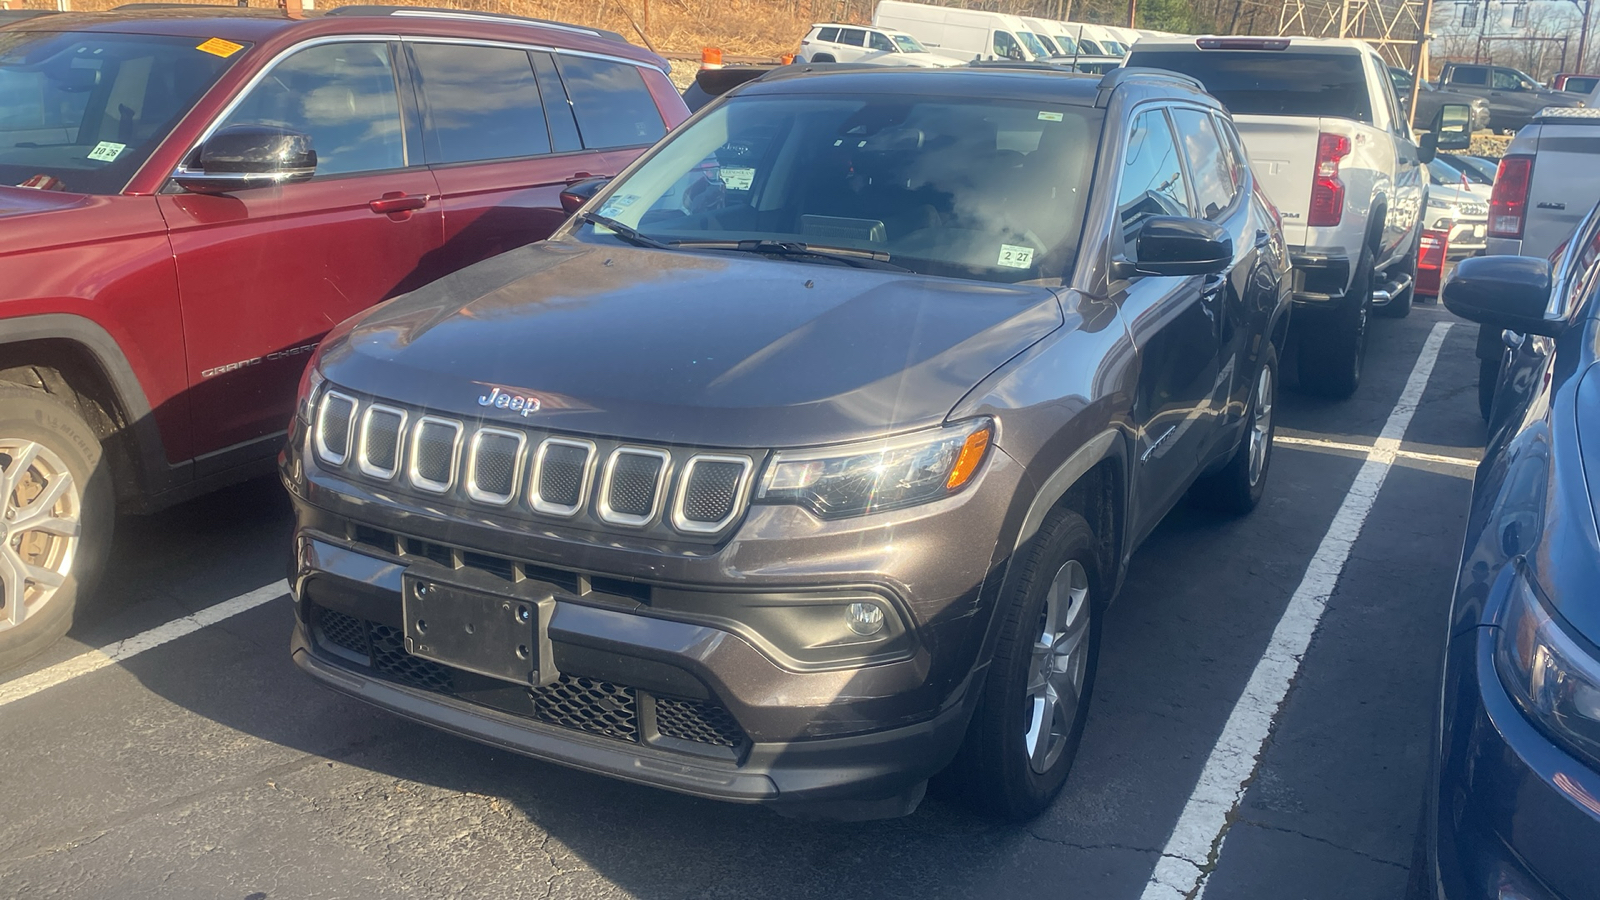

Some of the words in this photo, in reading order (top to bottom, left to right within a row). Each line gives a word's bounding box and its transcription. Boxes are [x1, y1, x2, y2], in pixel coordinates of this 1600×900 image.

[94, 147, 107, 155] 10
[106, 148, 119, 157] 26
[1004, 251, 1012, 261] 2
[1016, 252, 1029, 262] 27
[201, 356, 262, 378] GRAND
[478, 387, 541, 417] Jeep
[60, 423, 97, 465] MICHELI
